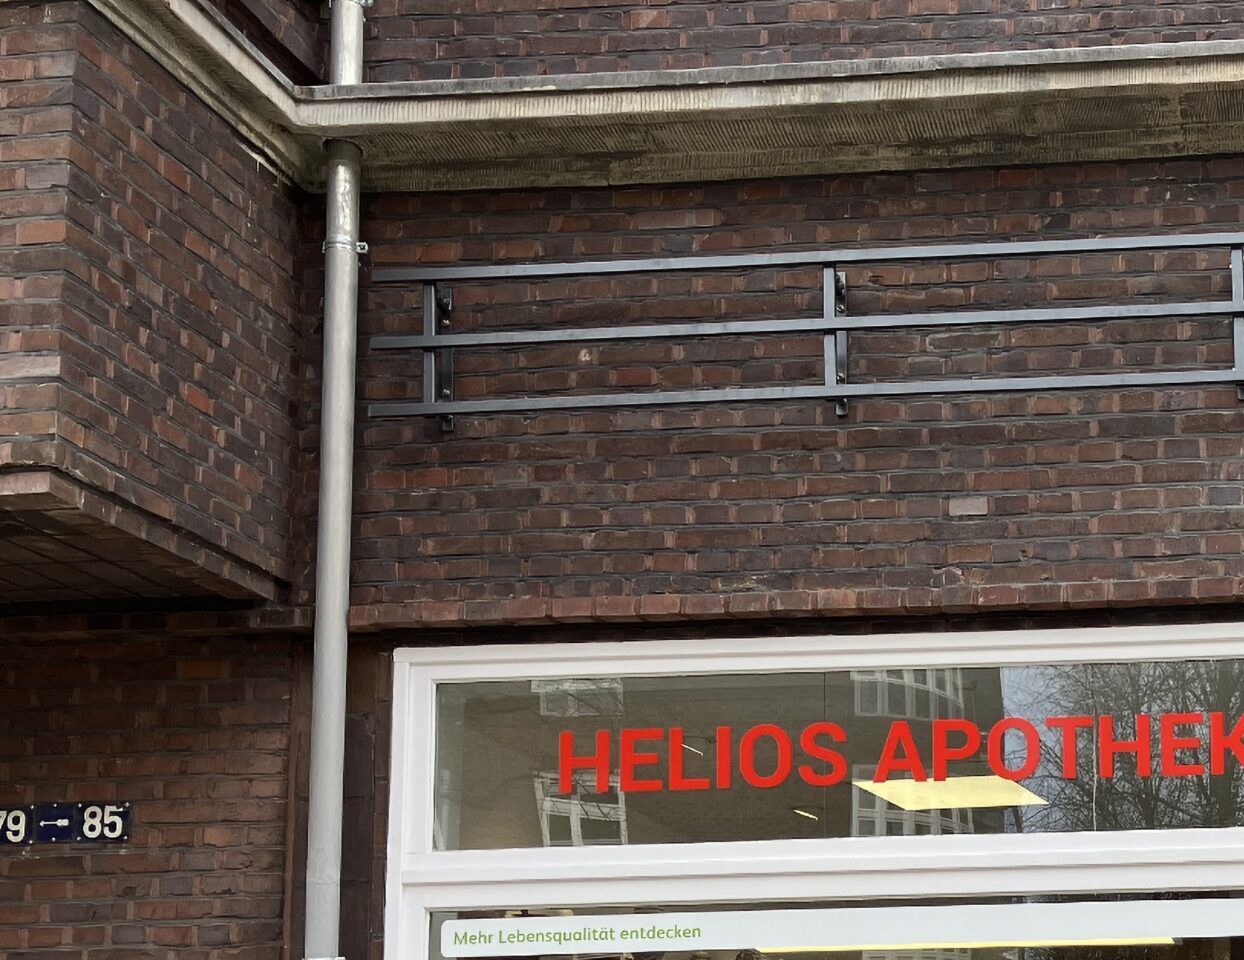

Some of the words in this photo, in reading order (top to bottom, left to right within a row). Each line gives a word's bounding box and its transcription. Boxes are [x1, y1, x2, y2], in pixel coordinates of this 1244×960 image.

[558, 721, 848, 794] HELIOS
[82, 804, 124, 839] 85
[453, 931, 494, 946] Mehr
[498, 927, 616, 948] Lebensqualität
[619, 924, 702, 941] entdecken
